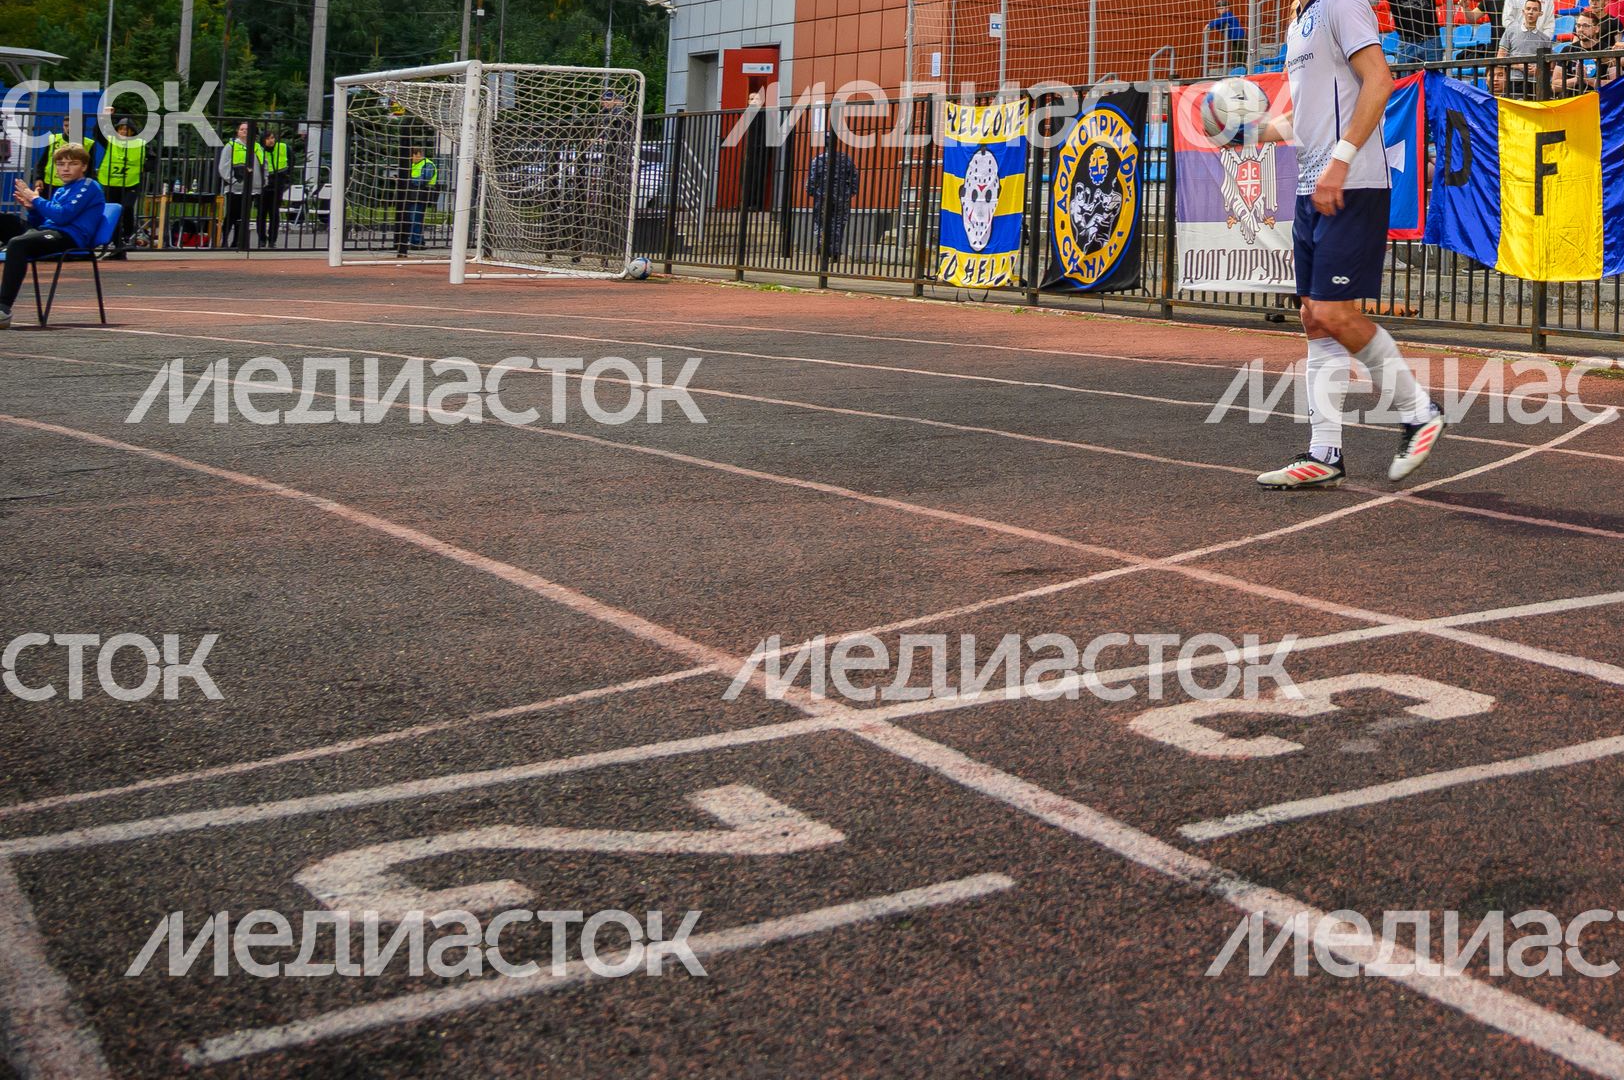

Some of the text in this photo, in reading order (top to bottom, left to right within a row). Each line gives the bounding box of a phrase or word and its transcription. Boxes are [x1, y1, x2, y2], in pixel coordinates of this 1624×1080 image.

[946, 100, 1027, 138] WELCOME
[1127, 672, 1497, 759] 3
[291, 783, 847, 922] 2
